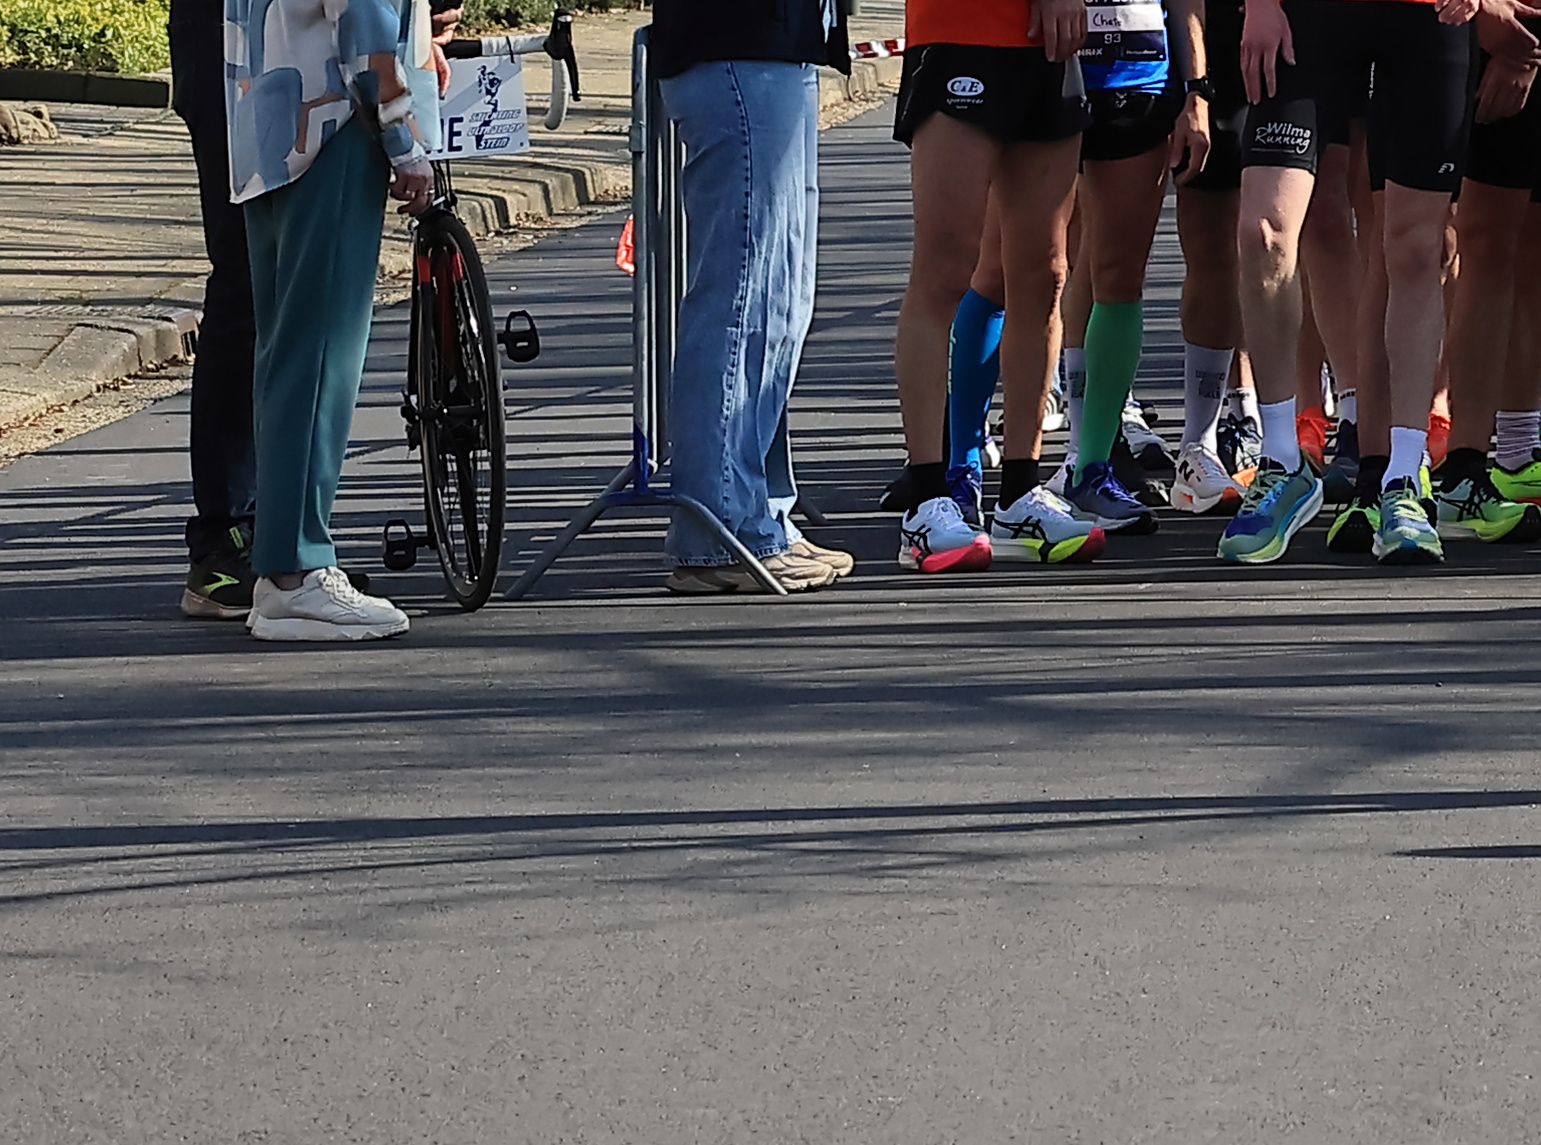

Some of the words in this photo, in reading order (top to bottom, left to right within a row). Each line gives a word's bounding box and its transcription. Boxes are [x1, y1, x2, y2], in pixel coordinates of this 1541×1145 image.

[1104, 33, 1122, 45] 93
[1266, 122, 1311, 138] Wilma
[1255, 127, 1311, 154] Running
